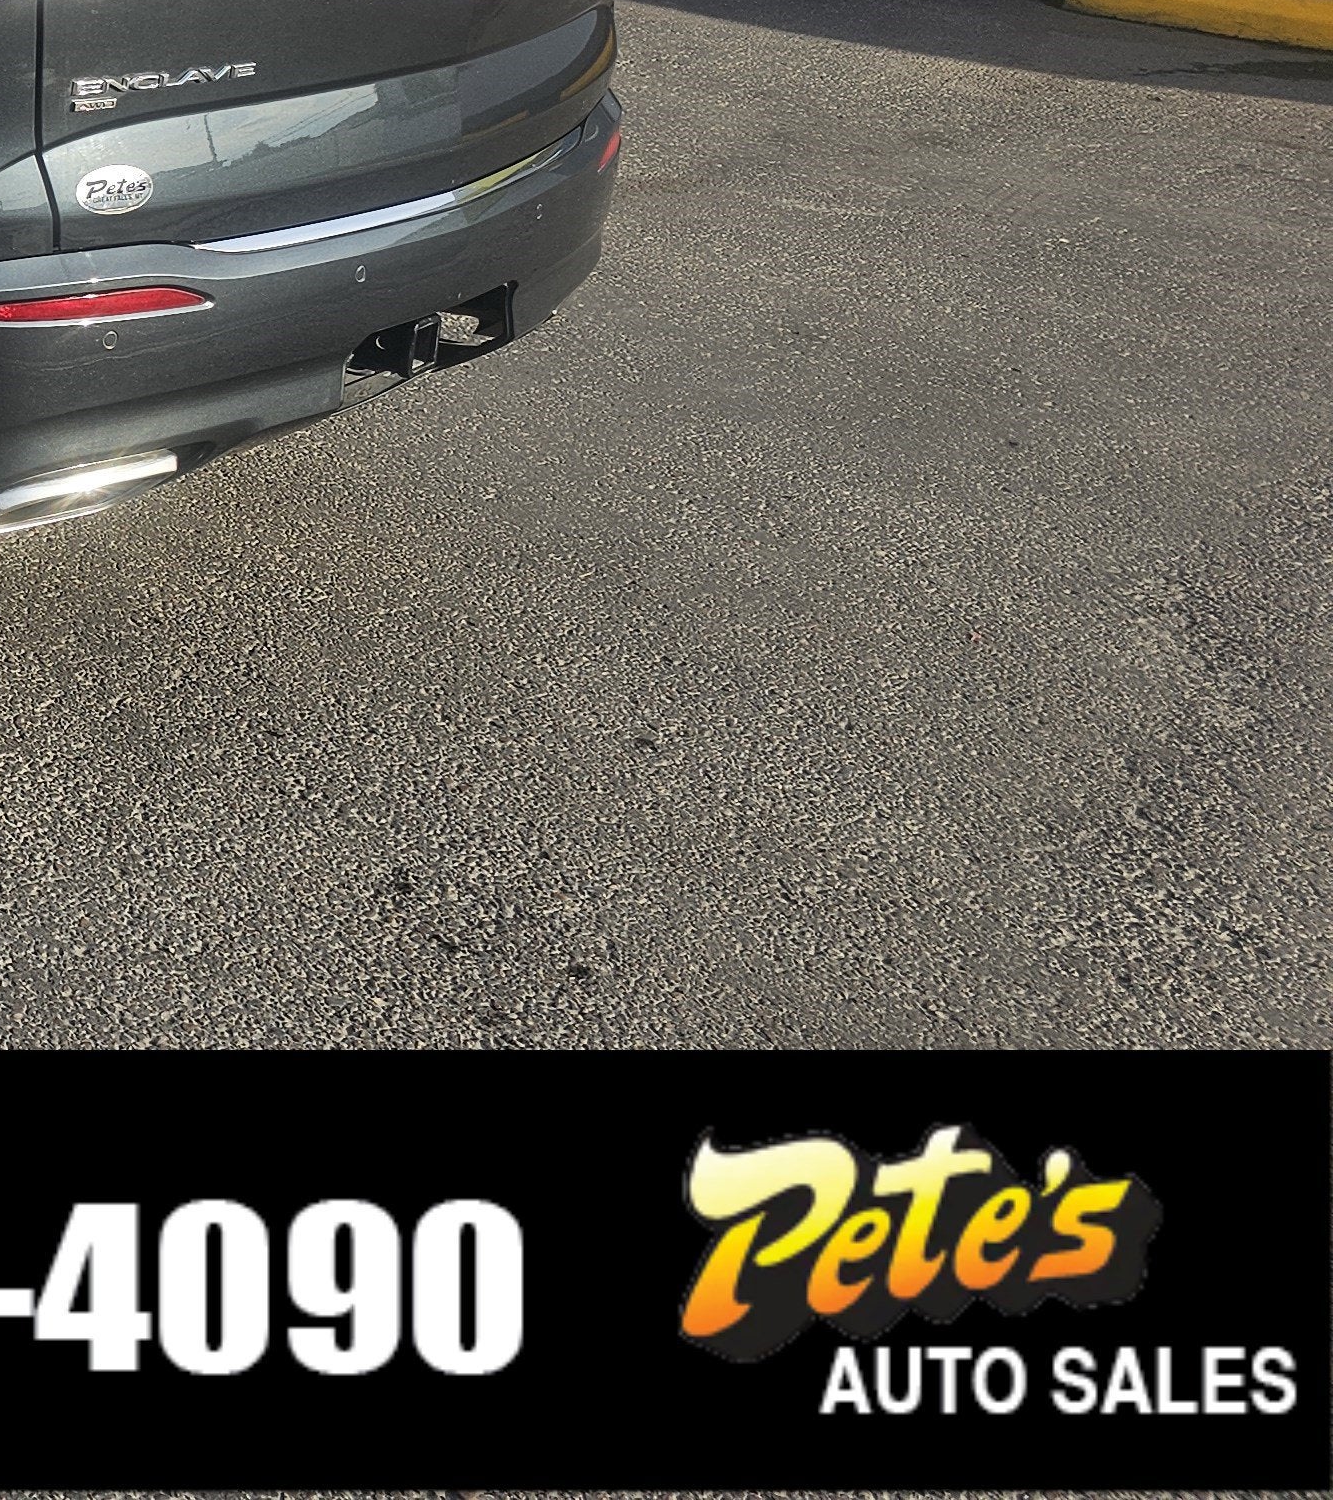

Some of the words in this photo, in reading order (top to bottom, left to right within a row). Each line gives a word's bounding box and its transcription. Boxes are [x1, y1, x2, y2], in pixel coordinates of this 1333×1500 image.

[71, 61, 257, 97] ENCLAVE
[76, 99, 116, 112] AWD
[86, 178, 147, 200] Pete's
